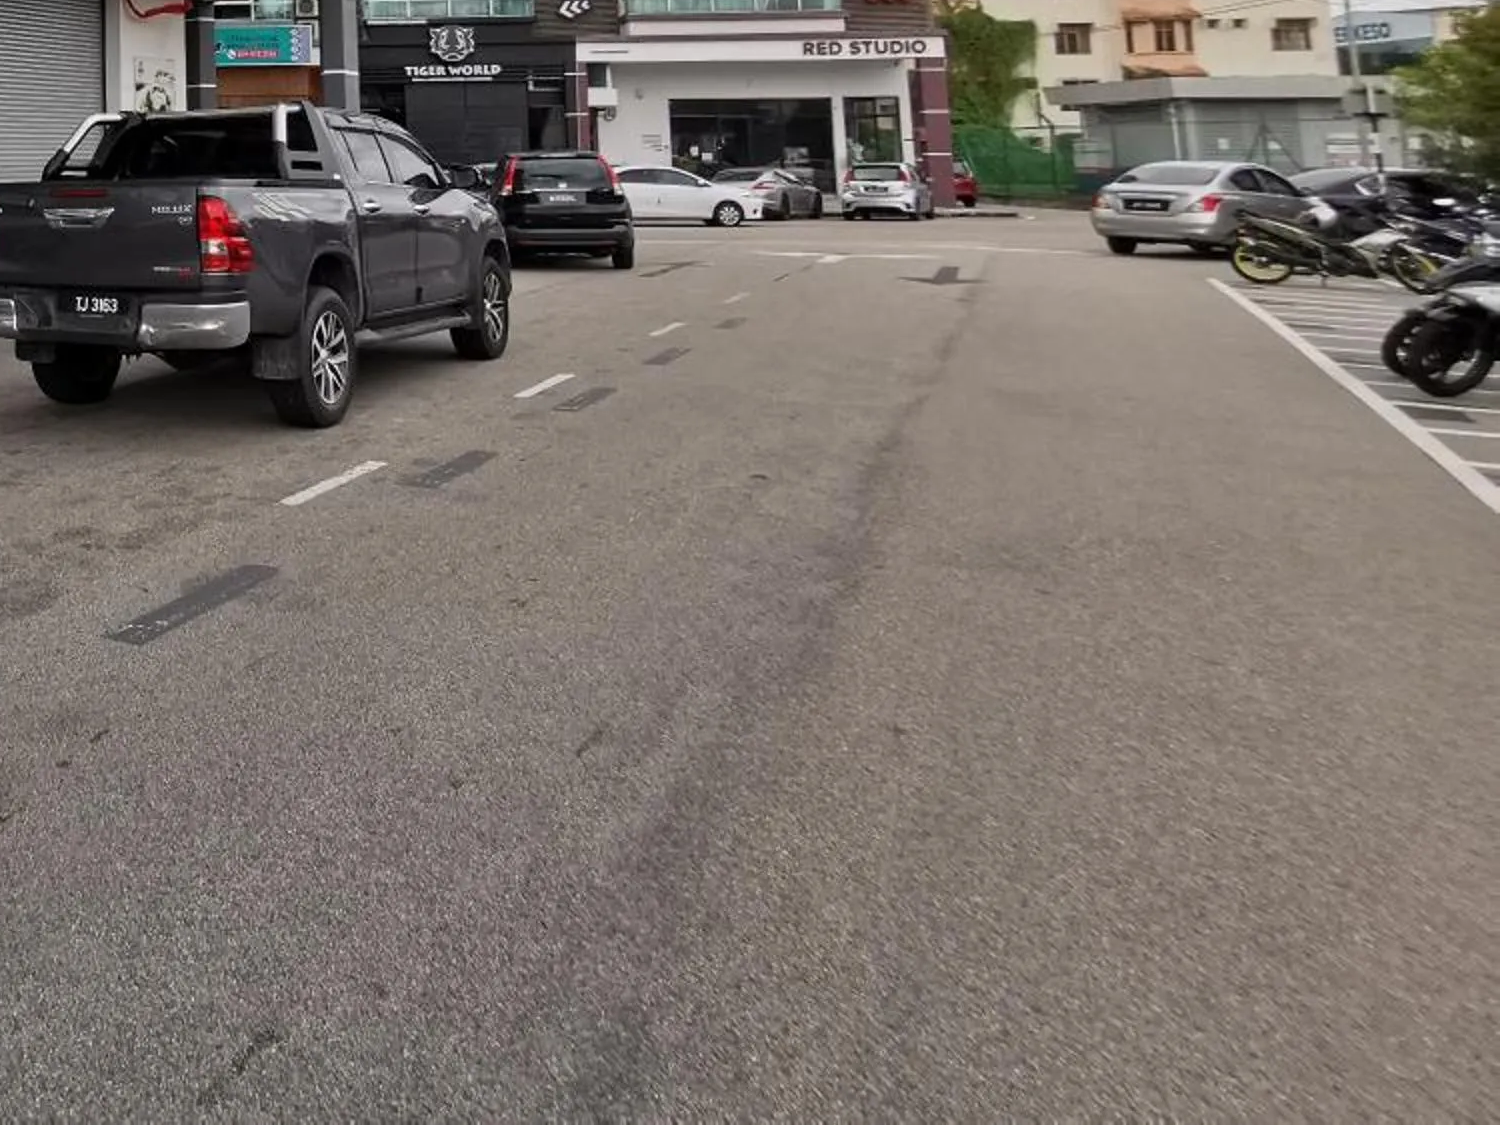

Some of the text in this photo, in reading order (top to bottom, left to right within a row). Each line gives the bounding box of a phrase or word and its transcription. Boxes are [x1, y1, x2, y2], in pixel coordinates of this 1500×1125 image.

[803, 39, 927, 56] RED STUDIO
[404, 64, 501, 76] TIGER WORLD
[75, 295, 89, 312] TJ
